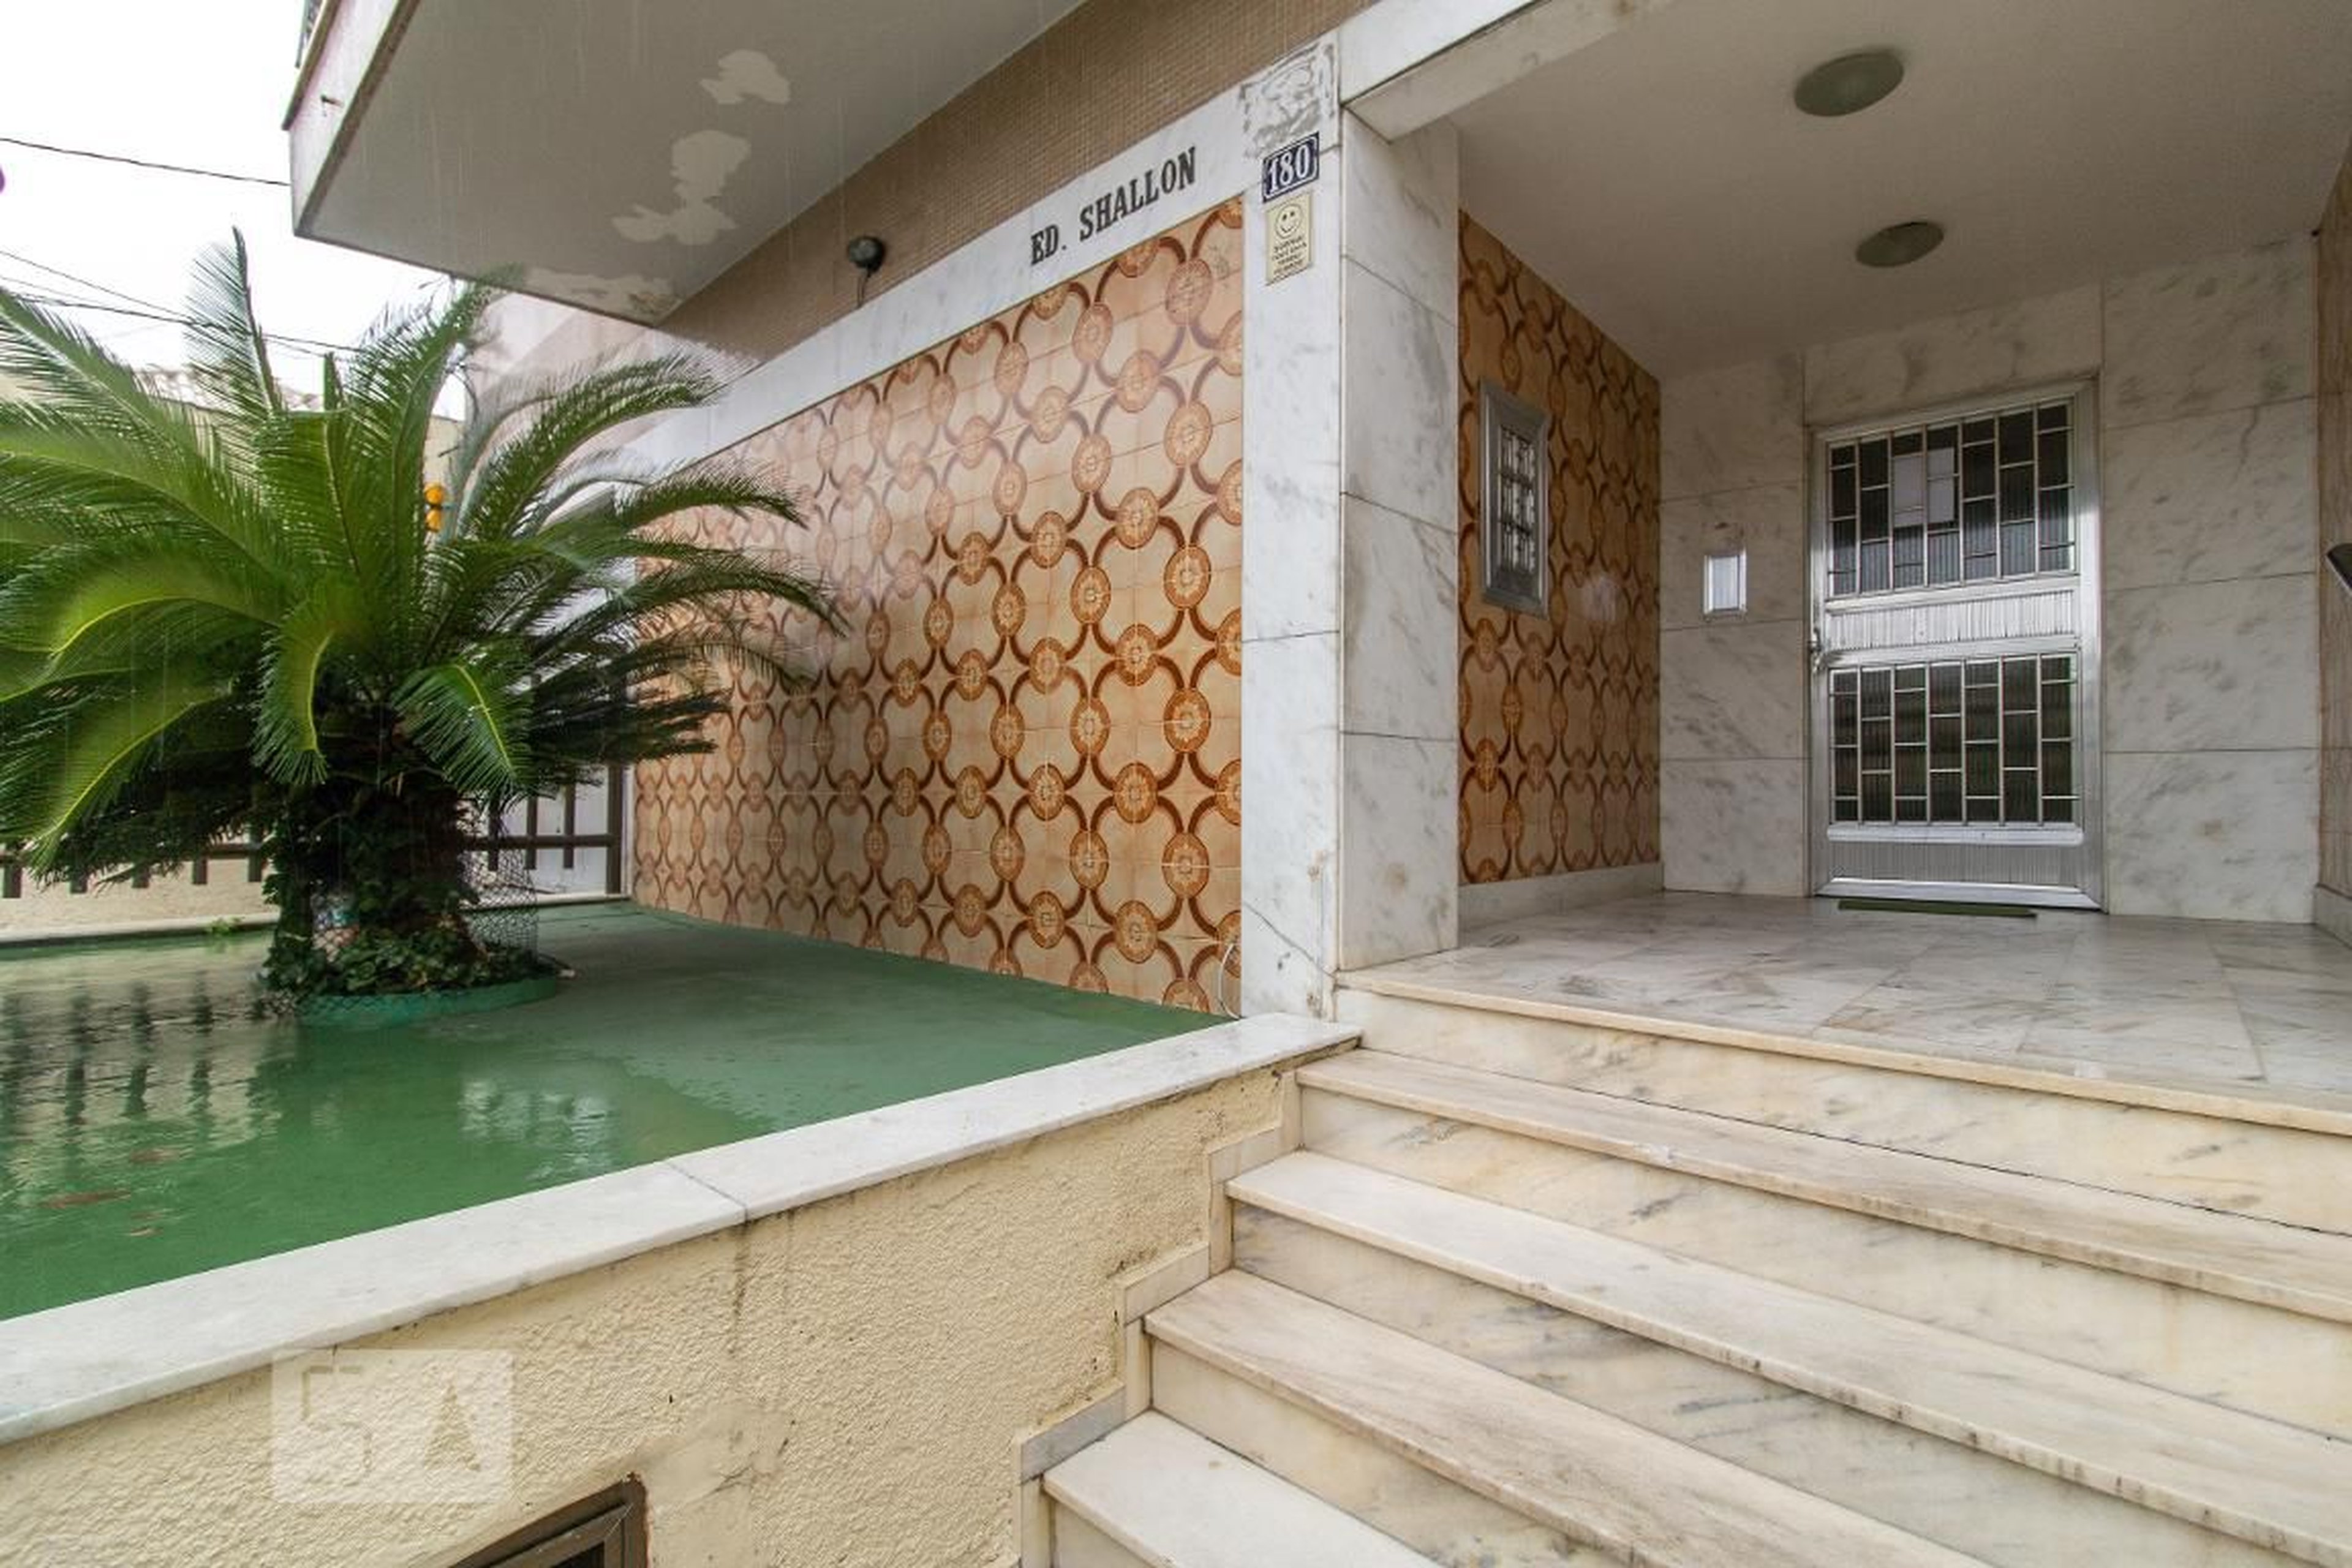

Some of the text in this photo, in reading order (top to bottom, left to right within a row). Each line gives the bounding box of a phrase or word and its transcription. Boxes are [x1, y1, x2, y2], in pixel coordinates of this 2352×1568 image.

[1030, 146, 1196, 266] ED. SHALLON
[1268, 143, 1310, 194] 180
